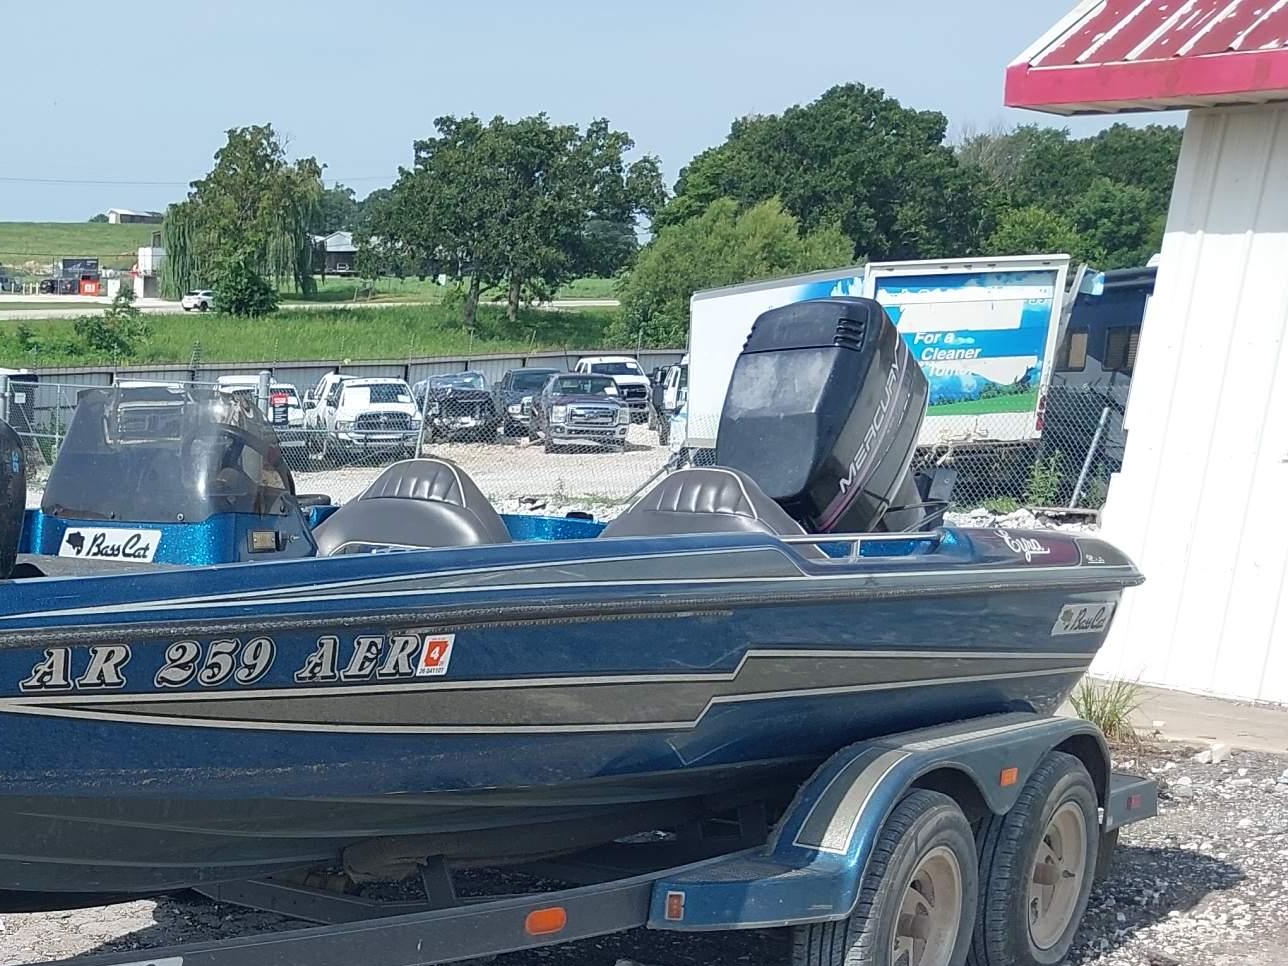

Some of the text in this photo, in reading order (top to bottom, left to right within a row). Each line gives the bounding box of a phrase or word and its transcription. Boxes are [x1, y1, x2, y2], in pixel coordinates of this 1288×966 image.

[914, 332, 955, 344] For a
[921, 347, 982, 360] Cleaner
[839, 362, 900, 494] MERCURY
[430, 646, 440, 660] 4
[19, 635, 421, 692] AR 259 AER
